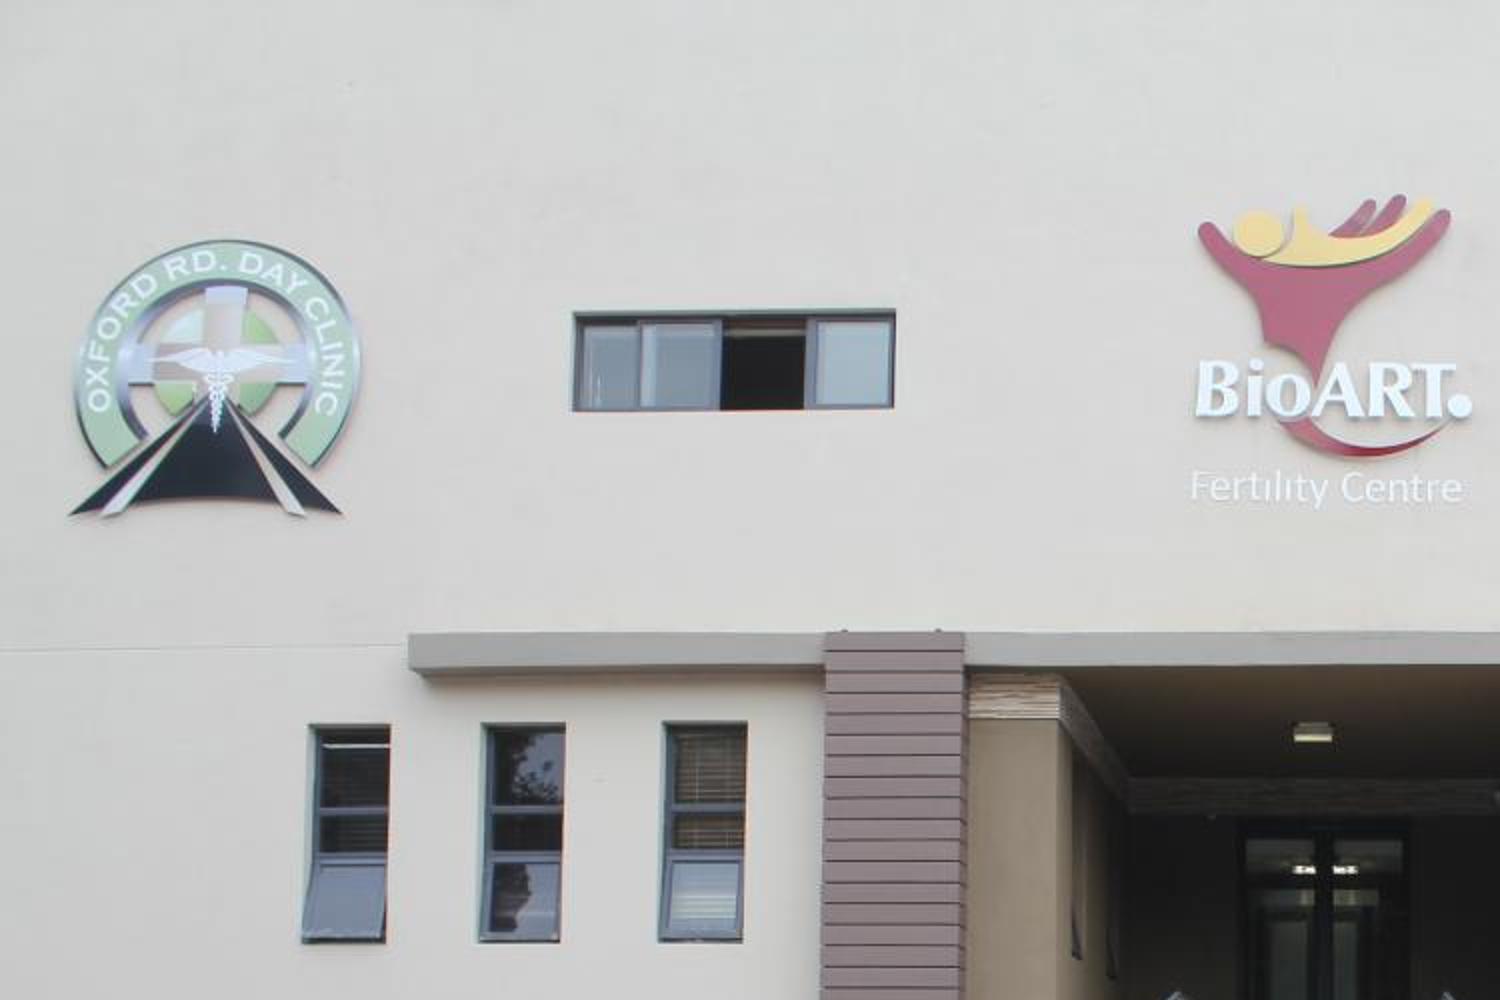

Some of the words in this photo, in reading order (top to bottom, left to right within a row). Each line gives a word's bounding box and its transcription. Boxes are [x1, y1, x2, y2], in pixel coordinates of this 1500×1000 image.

[84, 275, 158, 412] OXFORD
[240, 253, 308, 293] DAY
[304, 297, 346, 417] CLINIC
[1191, 470, 1328, 509] Fertility
[1341, 472, 1463, 504] Centre
